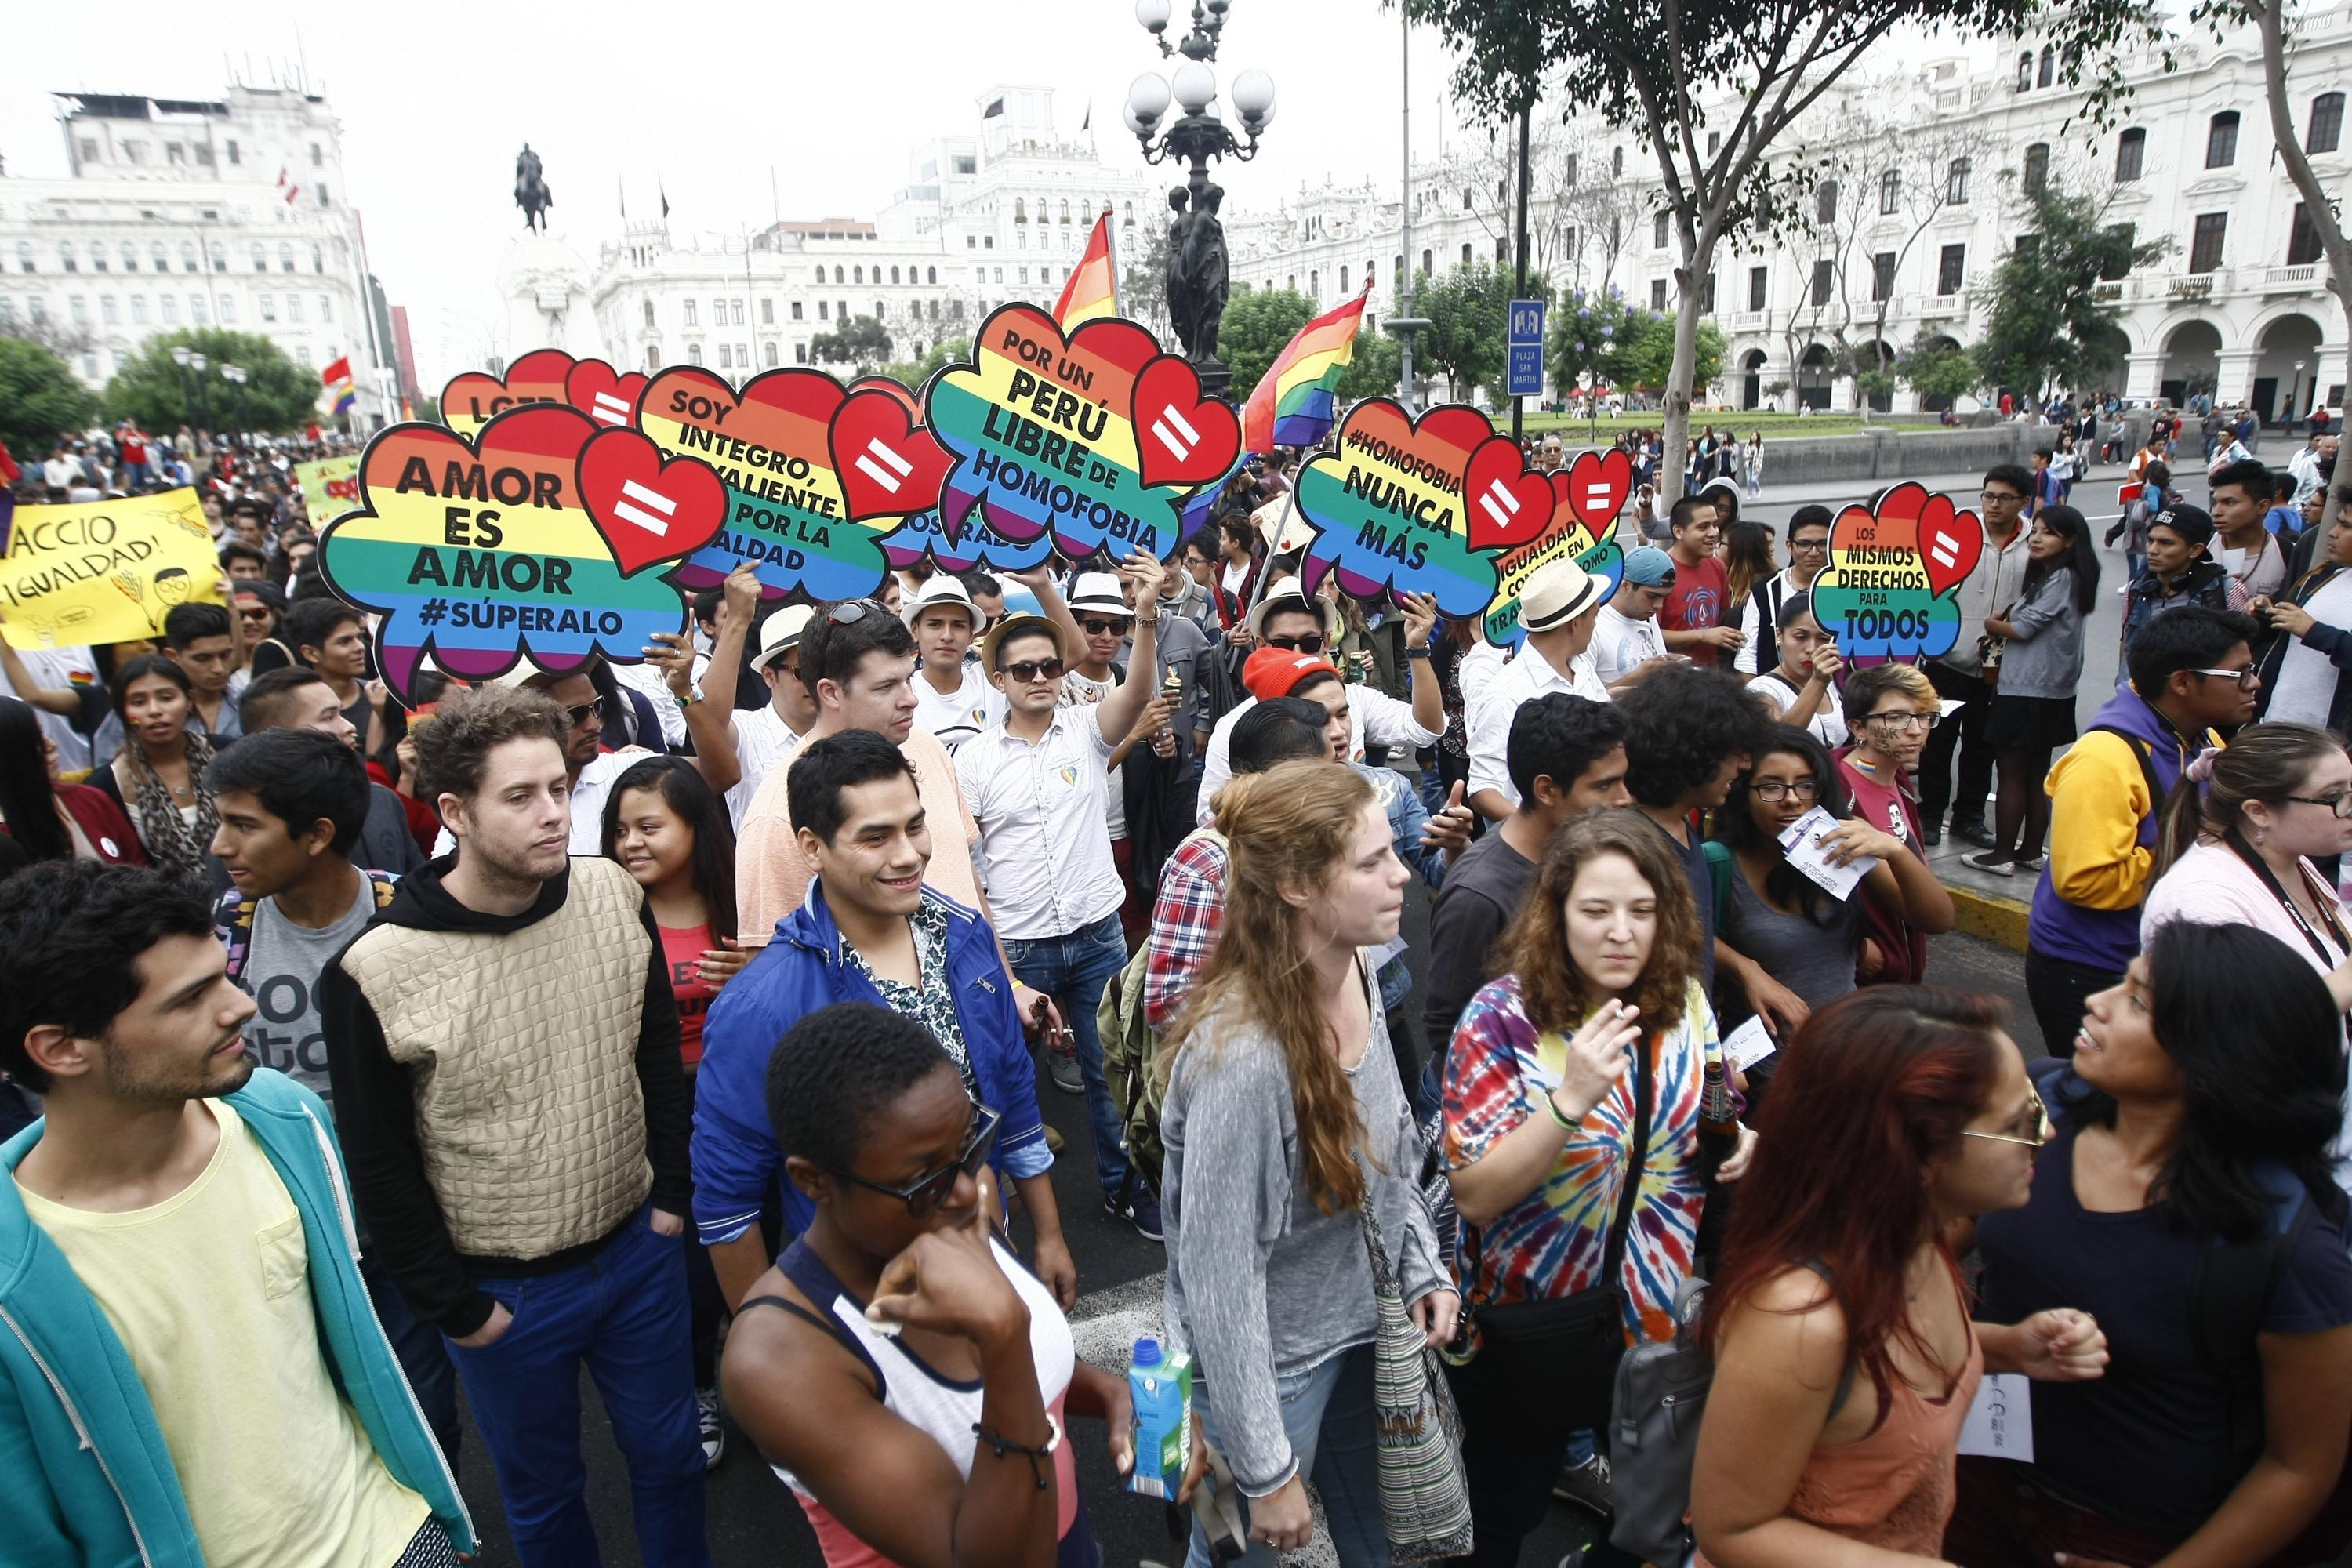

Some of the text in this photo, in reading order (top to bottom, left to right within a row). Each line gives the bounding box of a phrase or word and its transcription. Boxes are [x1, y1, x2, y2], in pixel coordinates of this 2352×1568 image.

[1002, 329, 1094, 392] POR UN
[1516, 352, 1535, 361] PLAZA
[1519, 364, 1531, 372] SAN
[669, 390, 733, 426] SOY
[1007, 368, 1108, 442] PERÚ
[678, 423, 817, 487] INTEGRO,
[982, 402, 1120, 492] LIBRE DE
[1345, 428, 1463, 498] #HOMOFOBIA
[395, 456, 563, 510] AMOR
[972, 448, 1157, 554] HOMOFOBIA
[1343, 465, 1454, 539] NUNCA
[11, 516, 117, 557] ACCIO
[445, 506, 503, 548] ES
[735, 503, 830, 548] POR LA
[1355, 519, 1429, 572] MÁS
[1568, 537, 1584, 559] EN
[1856, 528, 1875, 540] LOS
[3, 535, 164, 607] IGUALDAD!
[407, 547, 573, 595] AMOR
[1500, 520, 1577, 582] IGUALDAD
[1846, 544, 1914, 566] MISMOS
[1838, 569, 1924, 590] DERECHOS
[1859, 593, 1887, 605] PARA
[419, 597, 623, 636] #SÚPERALO
[1845, 608, 1929, 640] TODOS
